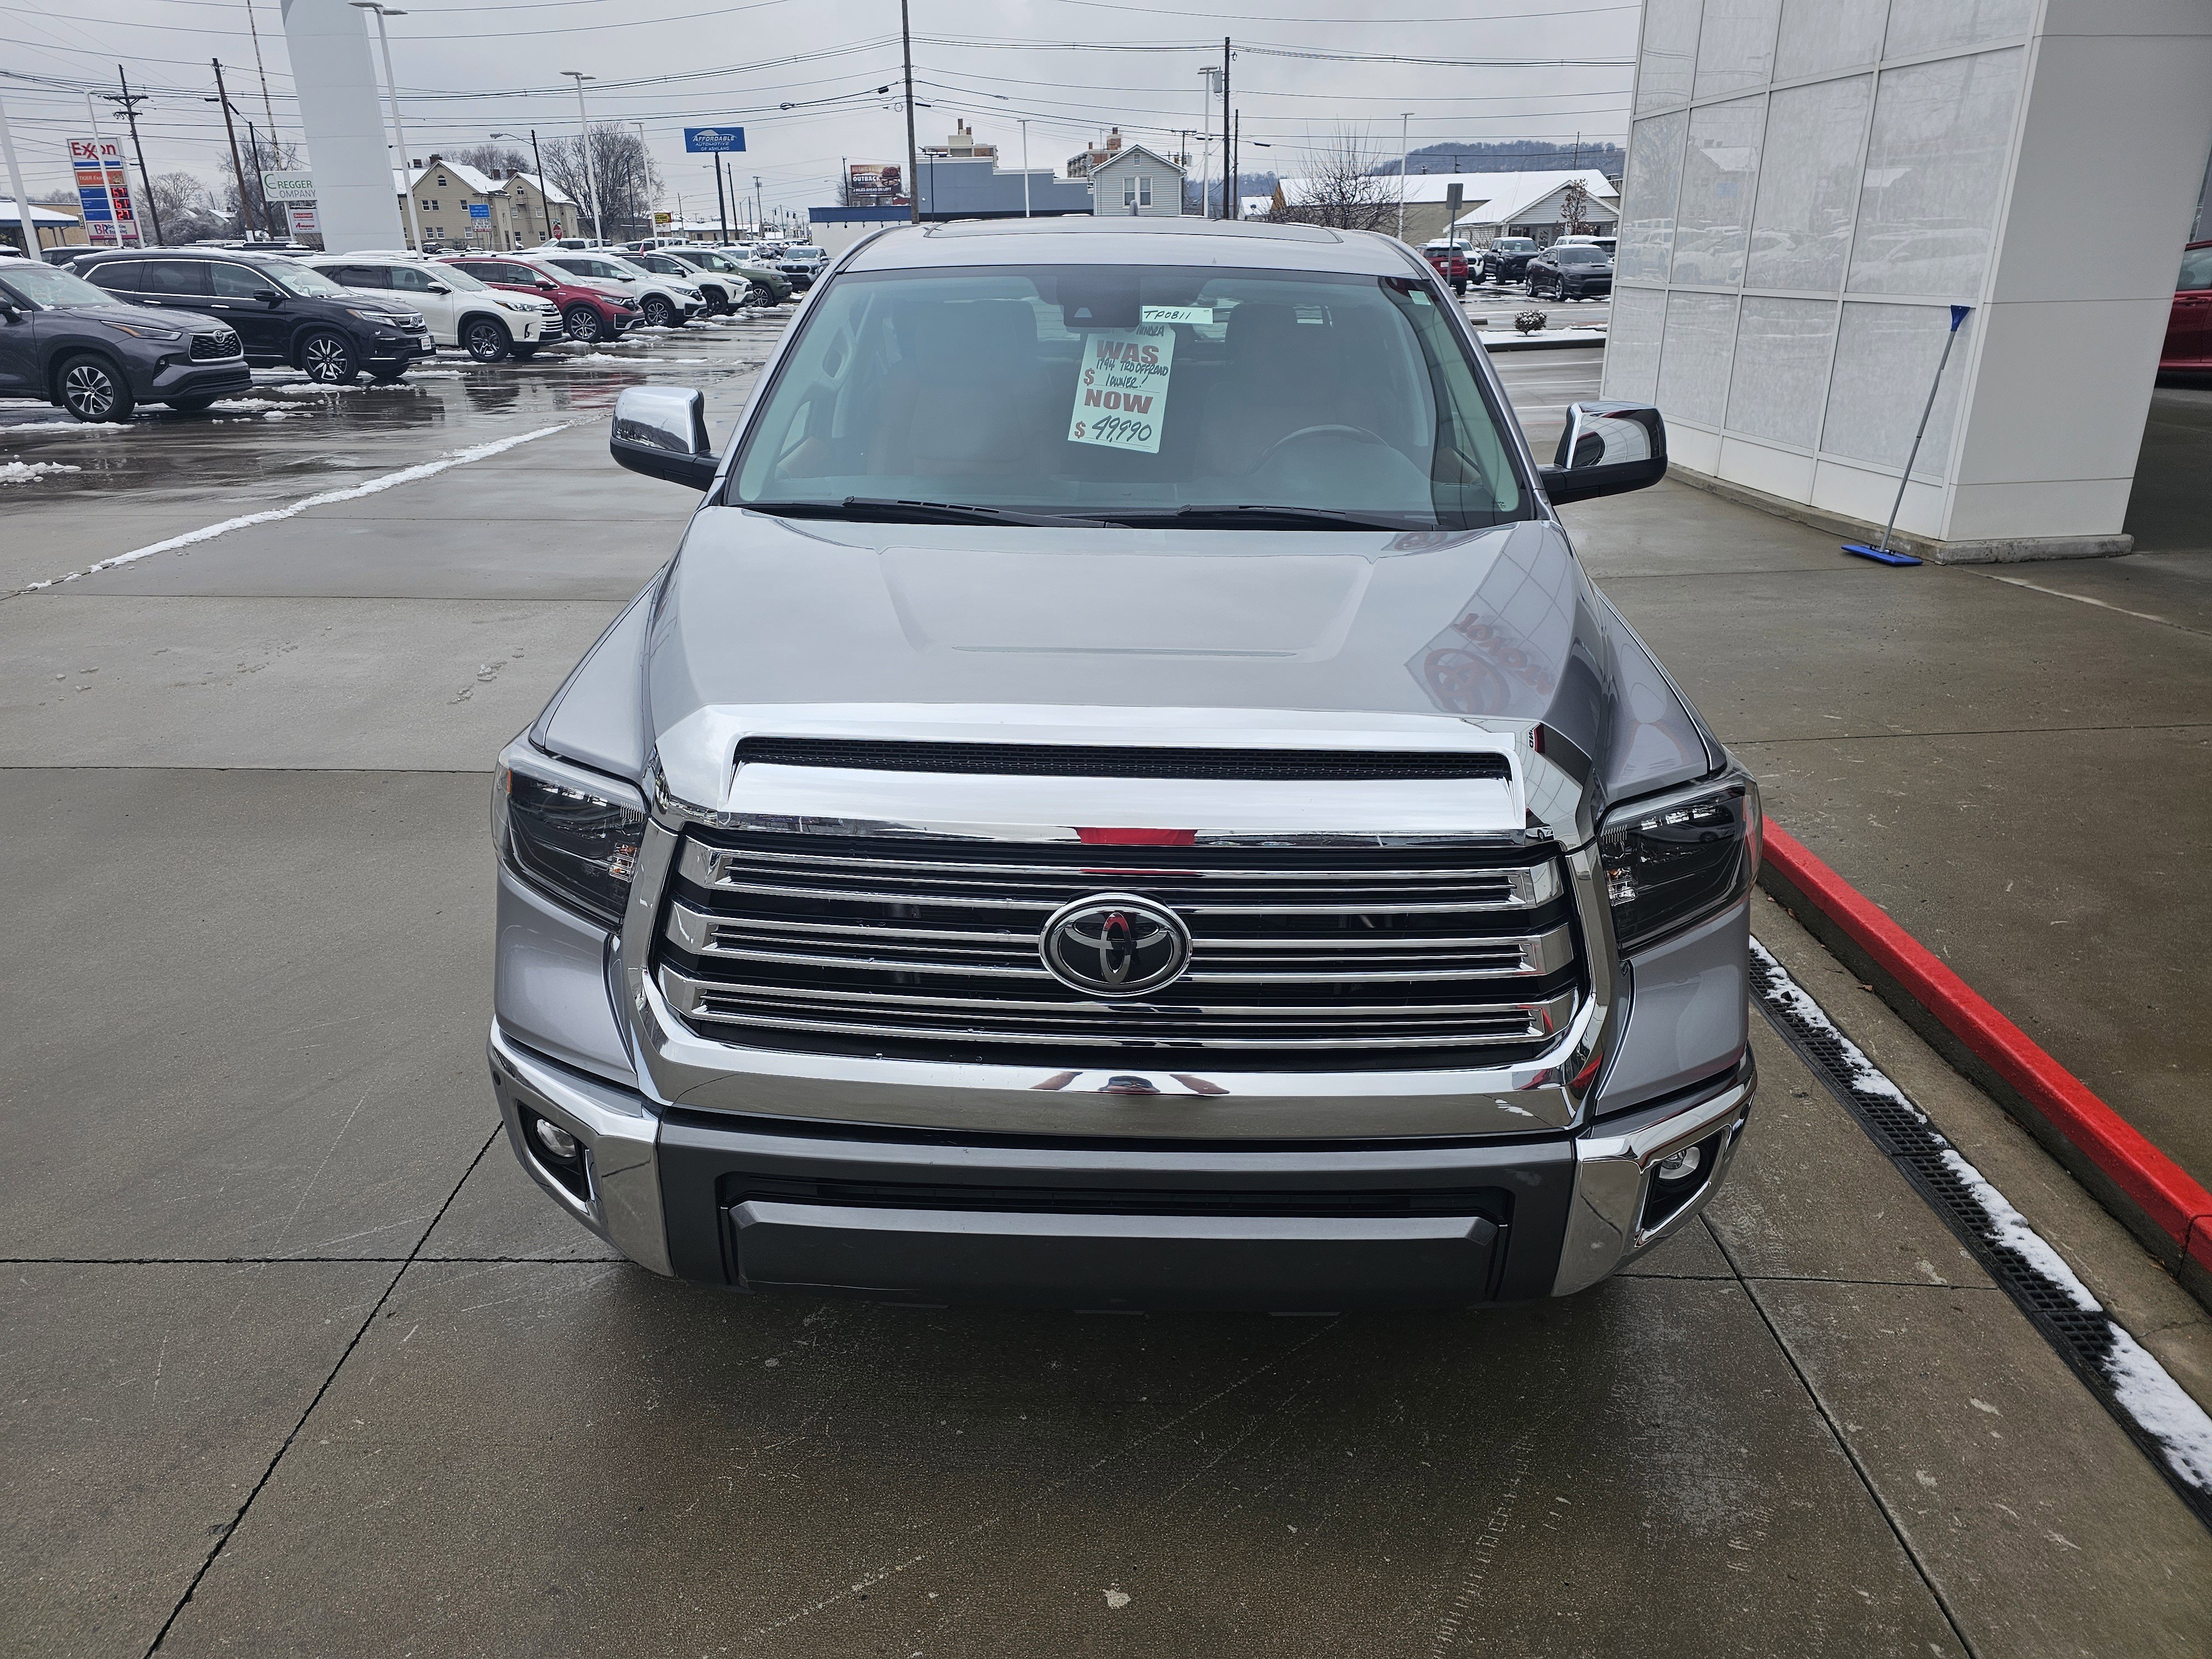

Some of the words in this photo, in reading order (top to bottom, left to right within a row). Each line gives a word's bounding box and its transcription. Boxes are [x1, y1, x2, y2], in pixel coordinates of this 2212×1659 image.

[1096, 339, 1159, 364] WAS
[1096, 357, 1115, 371] 1794
[1120, 359, 1135, 373] TRD
[1083, 367, 1095, 386] $
[1084, 388, 1154, 414] NOW
[1074, 420, 1086, 439] $
